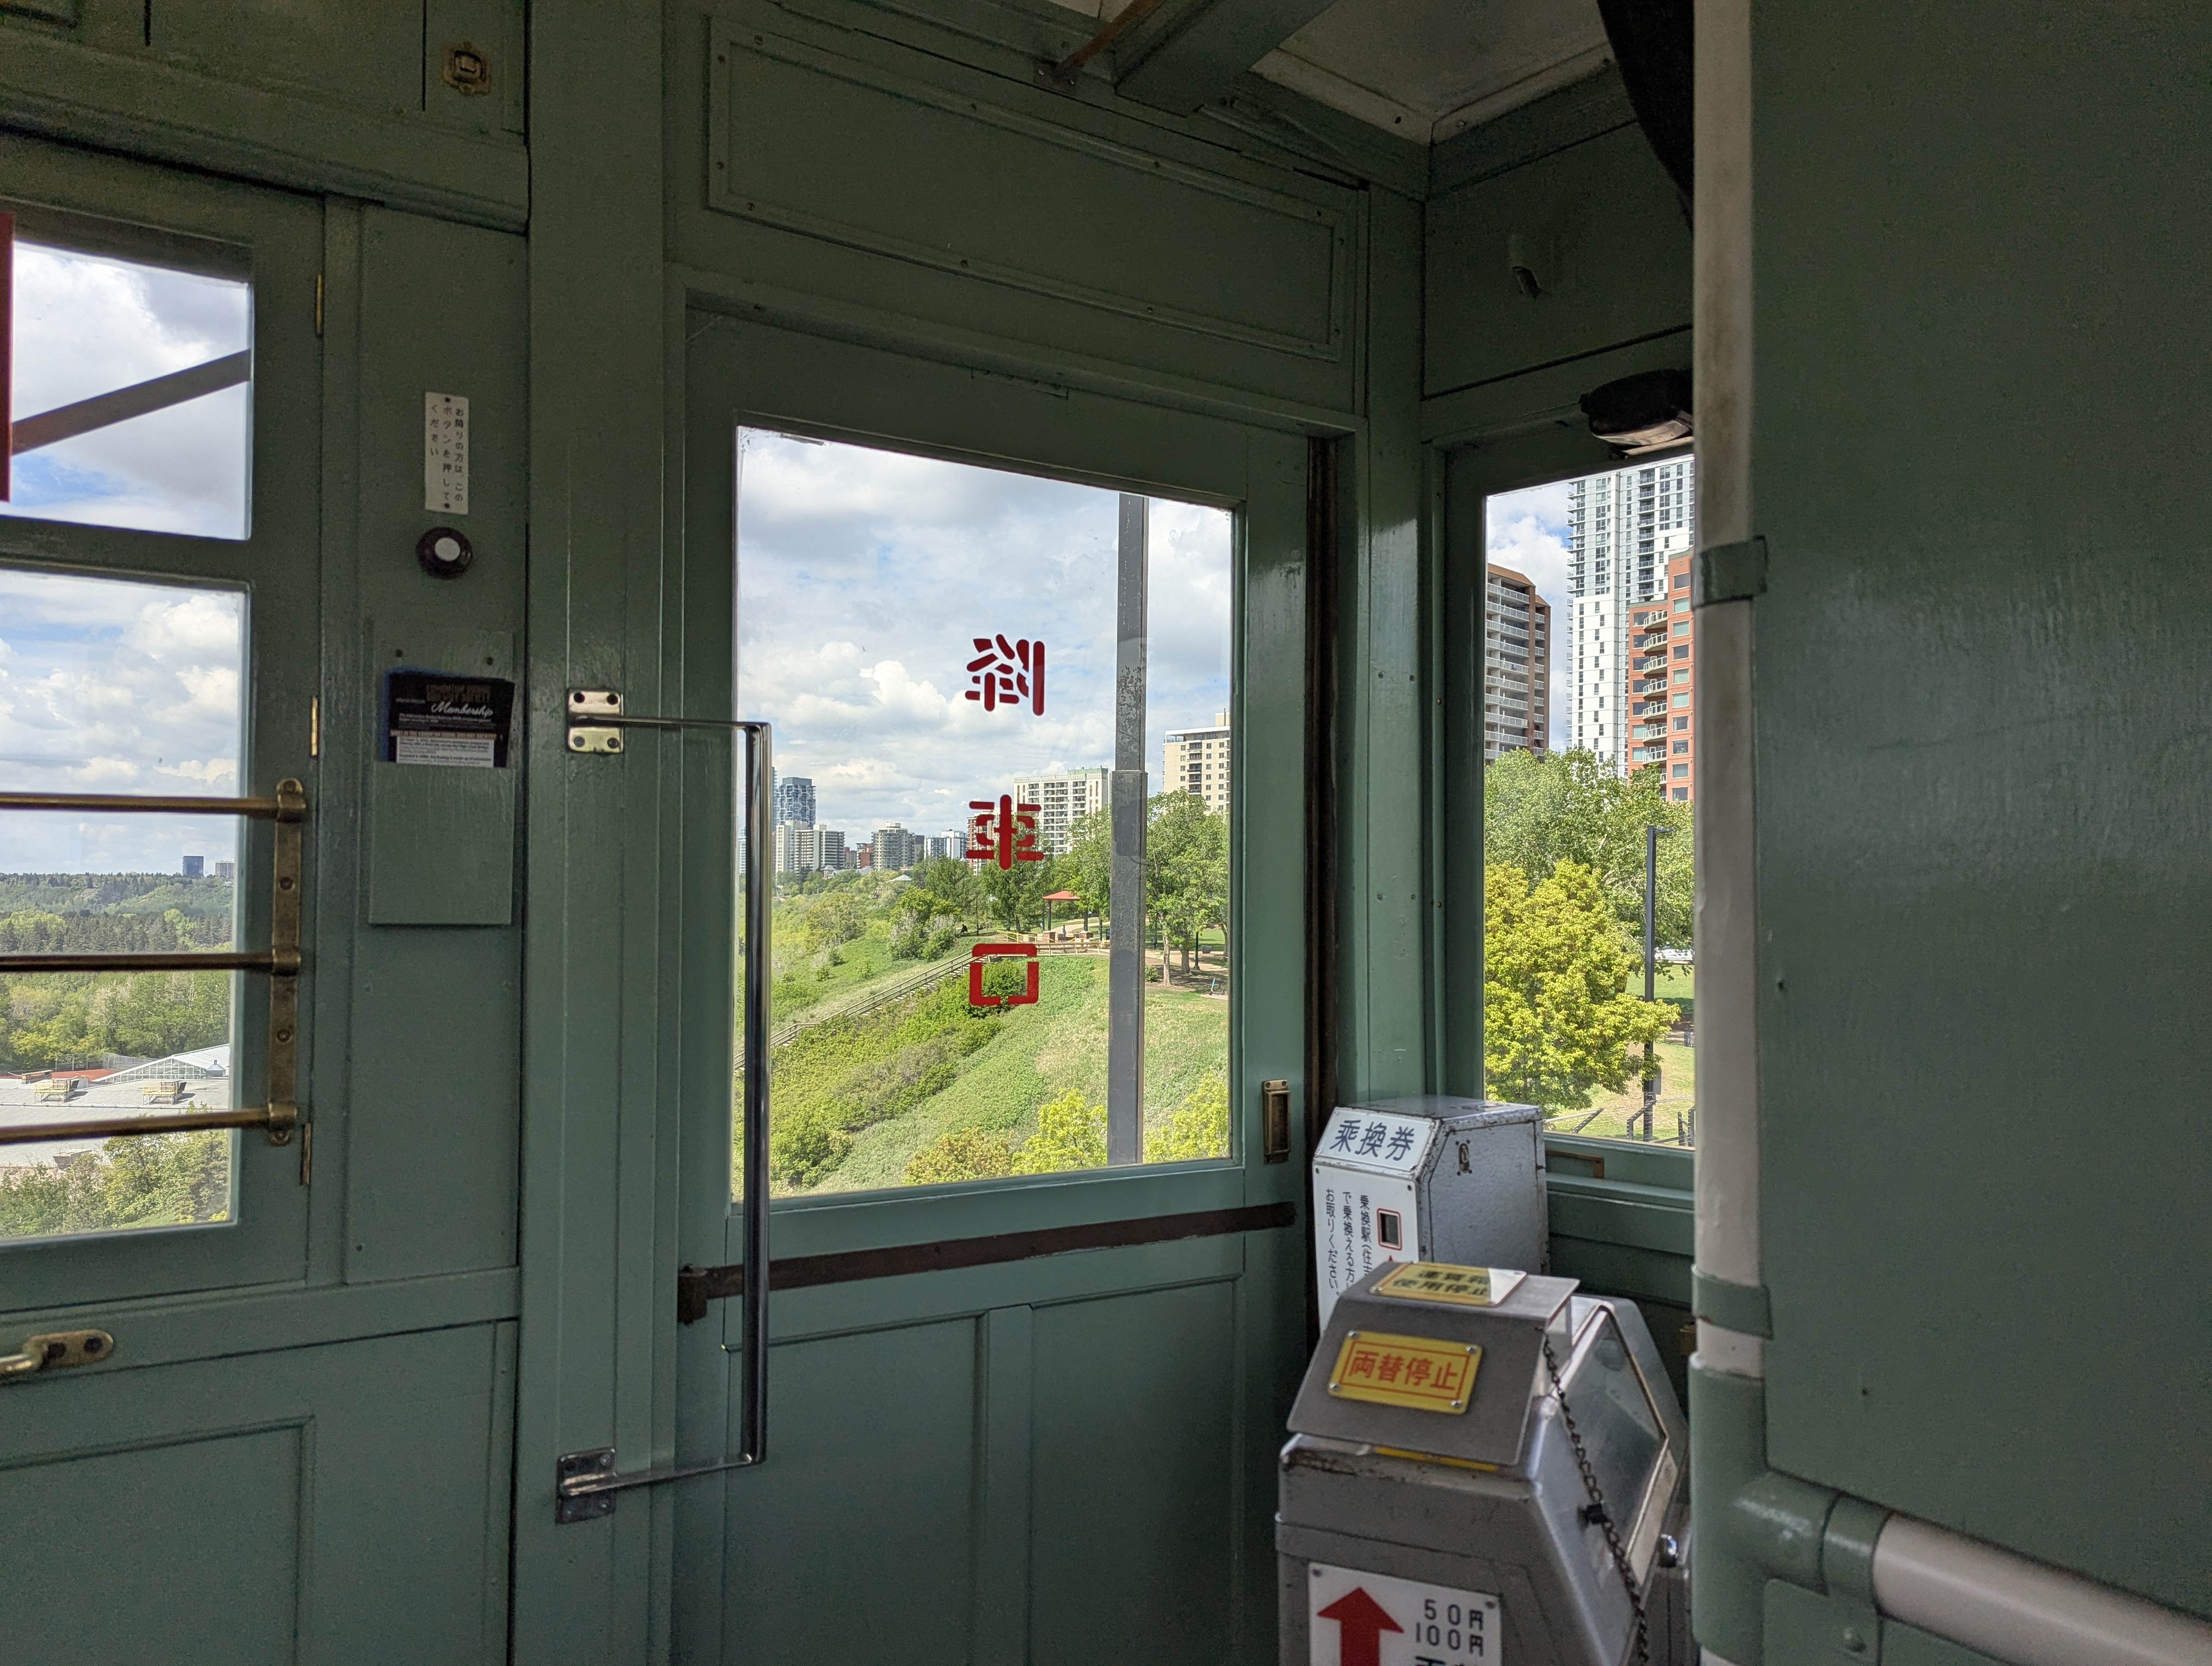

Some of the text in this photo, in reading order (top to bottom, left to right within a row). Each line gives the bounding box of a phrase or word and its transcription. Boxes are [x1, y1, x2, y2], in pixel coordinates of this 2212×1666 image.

[430, 404, 439, 456] ください
[432, 701, 493, 717] Membership
[1330, 1119, 1414, 1161] 乗換券
[1325, 1188, 1341, 1296] お取りください。
[1342, 1191, 1355, 1289] で乗換える方
[1349, 1351, 1458, 1390] 両替停止
[1425, 1599, 1483, 1630] 50円
[1416, 1623, 1483, 1656] 100円
